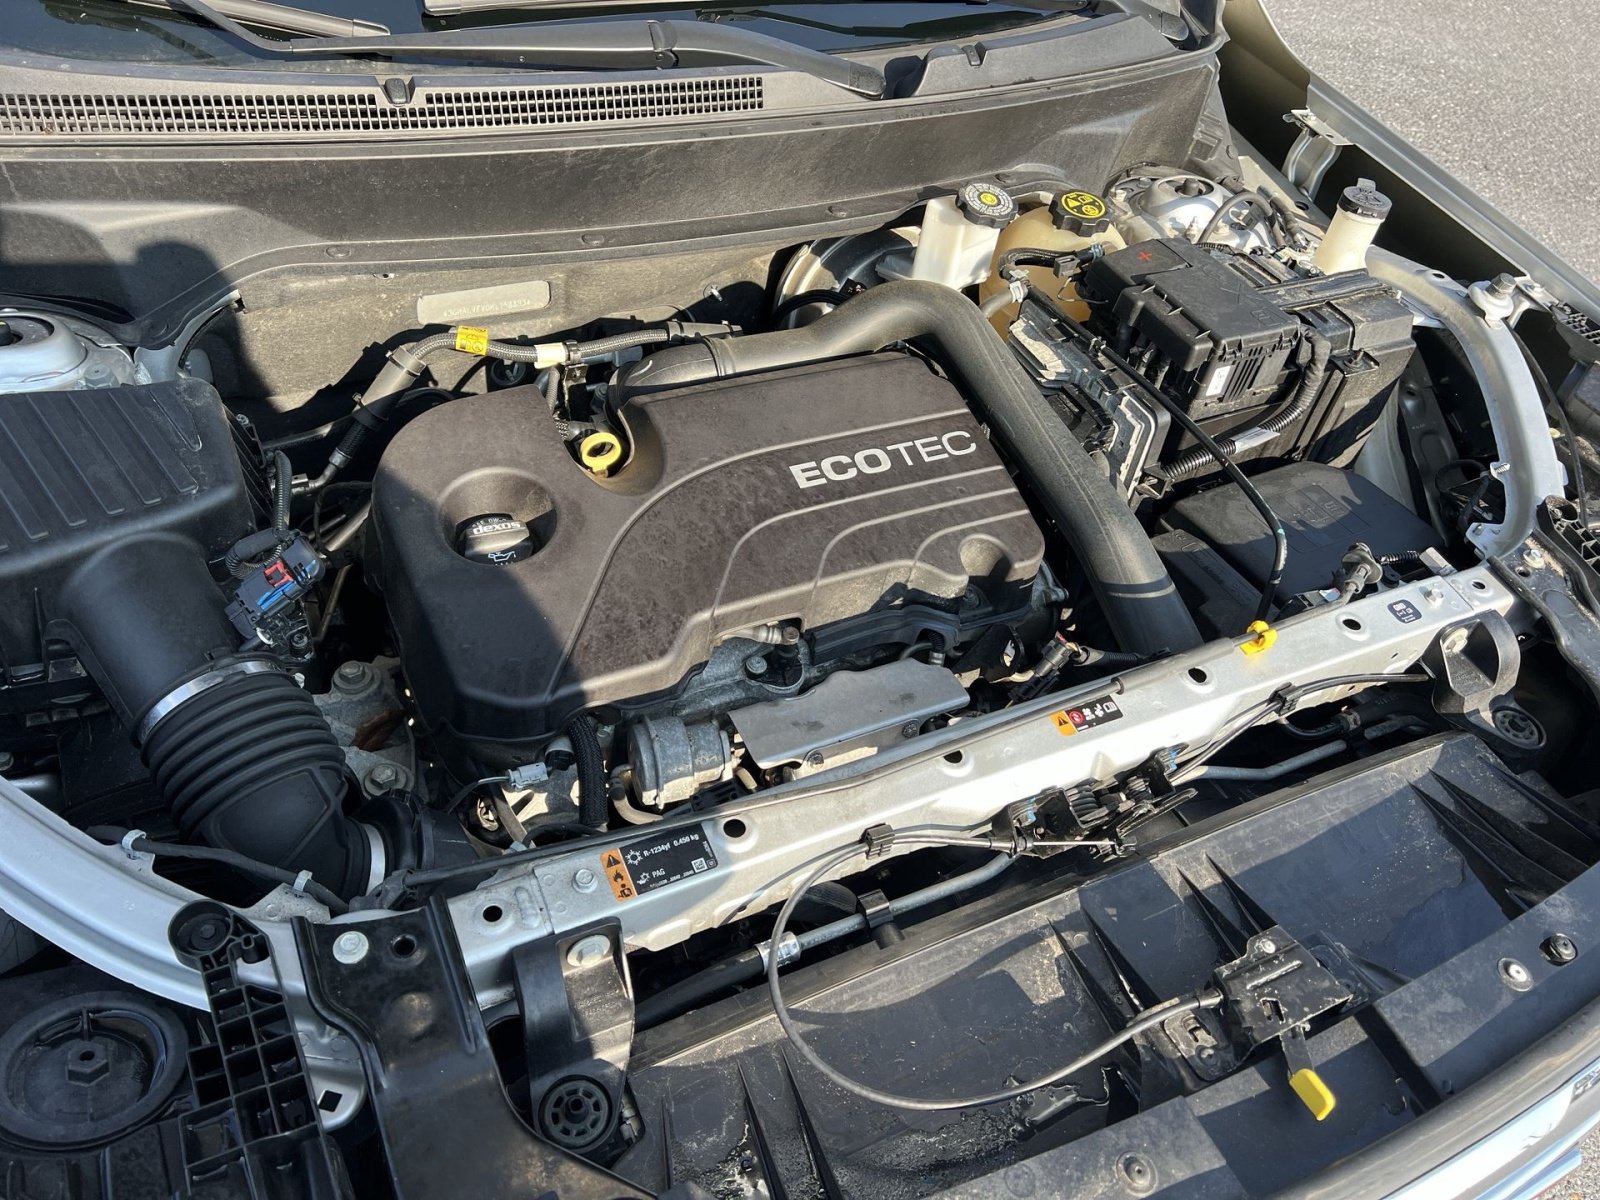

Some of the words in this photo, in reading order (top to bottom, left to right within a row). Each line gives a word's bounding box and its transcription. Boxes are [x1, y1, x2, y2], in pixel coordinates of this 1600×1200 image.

[789, 431, 977, 489] ECOTEC
[473, 522, 521, 534] dexos
[643, 842, 671, 857] R-1234yf
[673, 836, 690, 846] 0.450
[690, 833, 699, 841] kg
[652, 868, 666, 878] PAG
